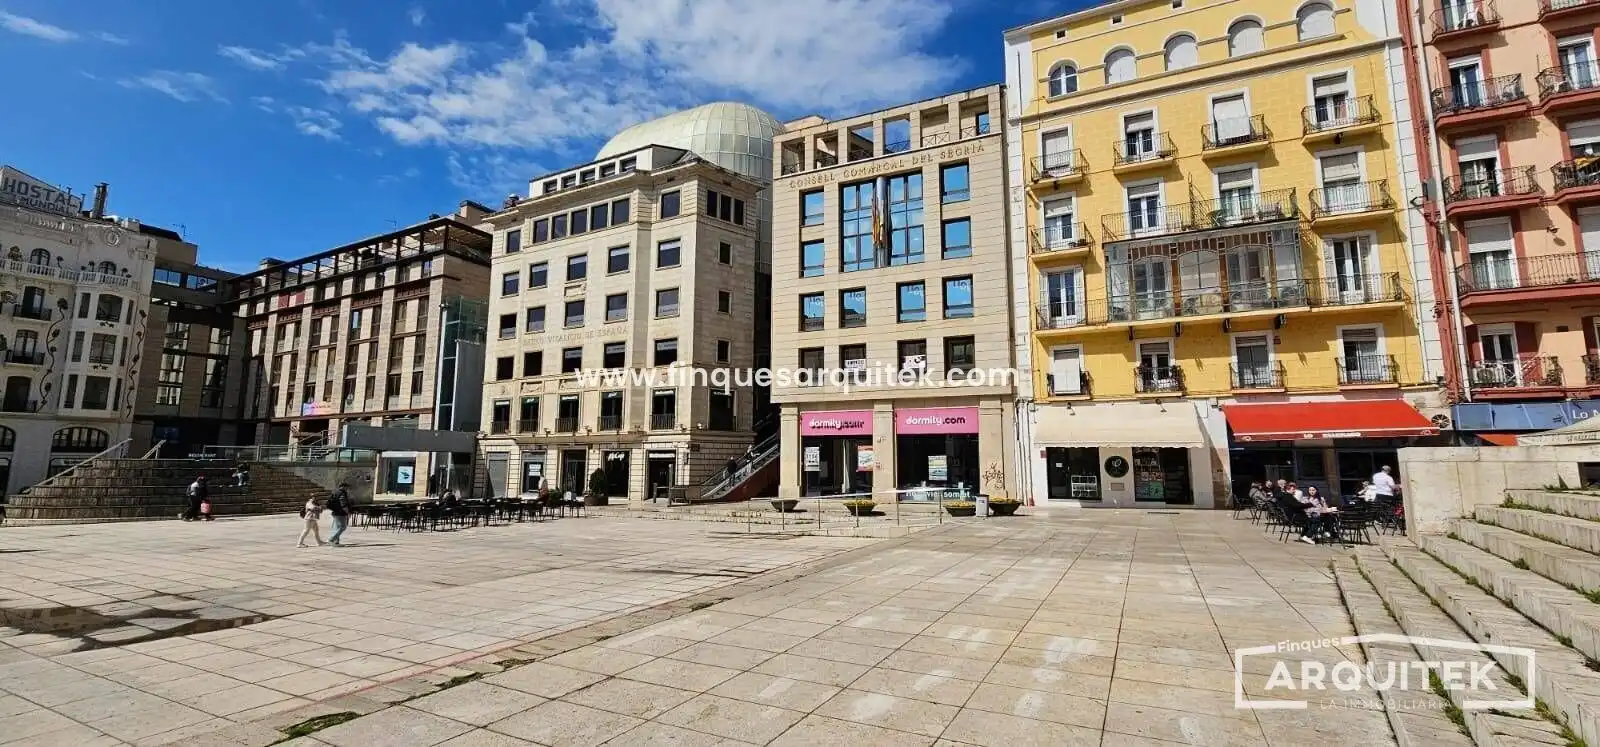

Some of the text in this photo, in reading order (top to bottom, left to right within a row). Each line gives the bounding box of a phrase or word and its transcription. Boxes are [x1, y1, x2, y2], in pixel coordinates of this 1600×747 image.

[789, 172, 835, 189] CONSELL
[843, 160, 904, 178] COMARCAL
[912, 153, 934, 166] DEL
[3, 177, 77, 208] HOSTAL
[21, 196, 74, 217] MUNDIAL
[906, 415, 966, 426] dormity.com
[1572, 409, 1589, 419] Lo
